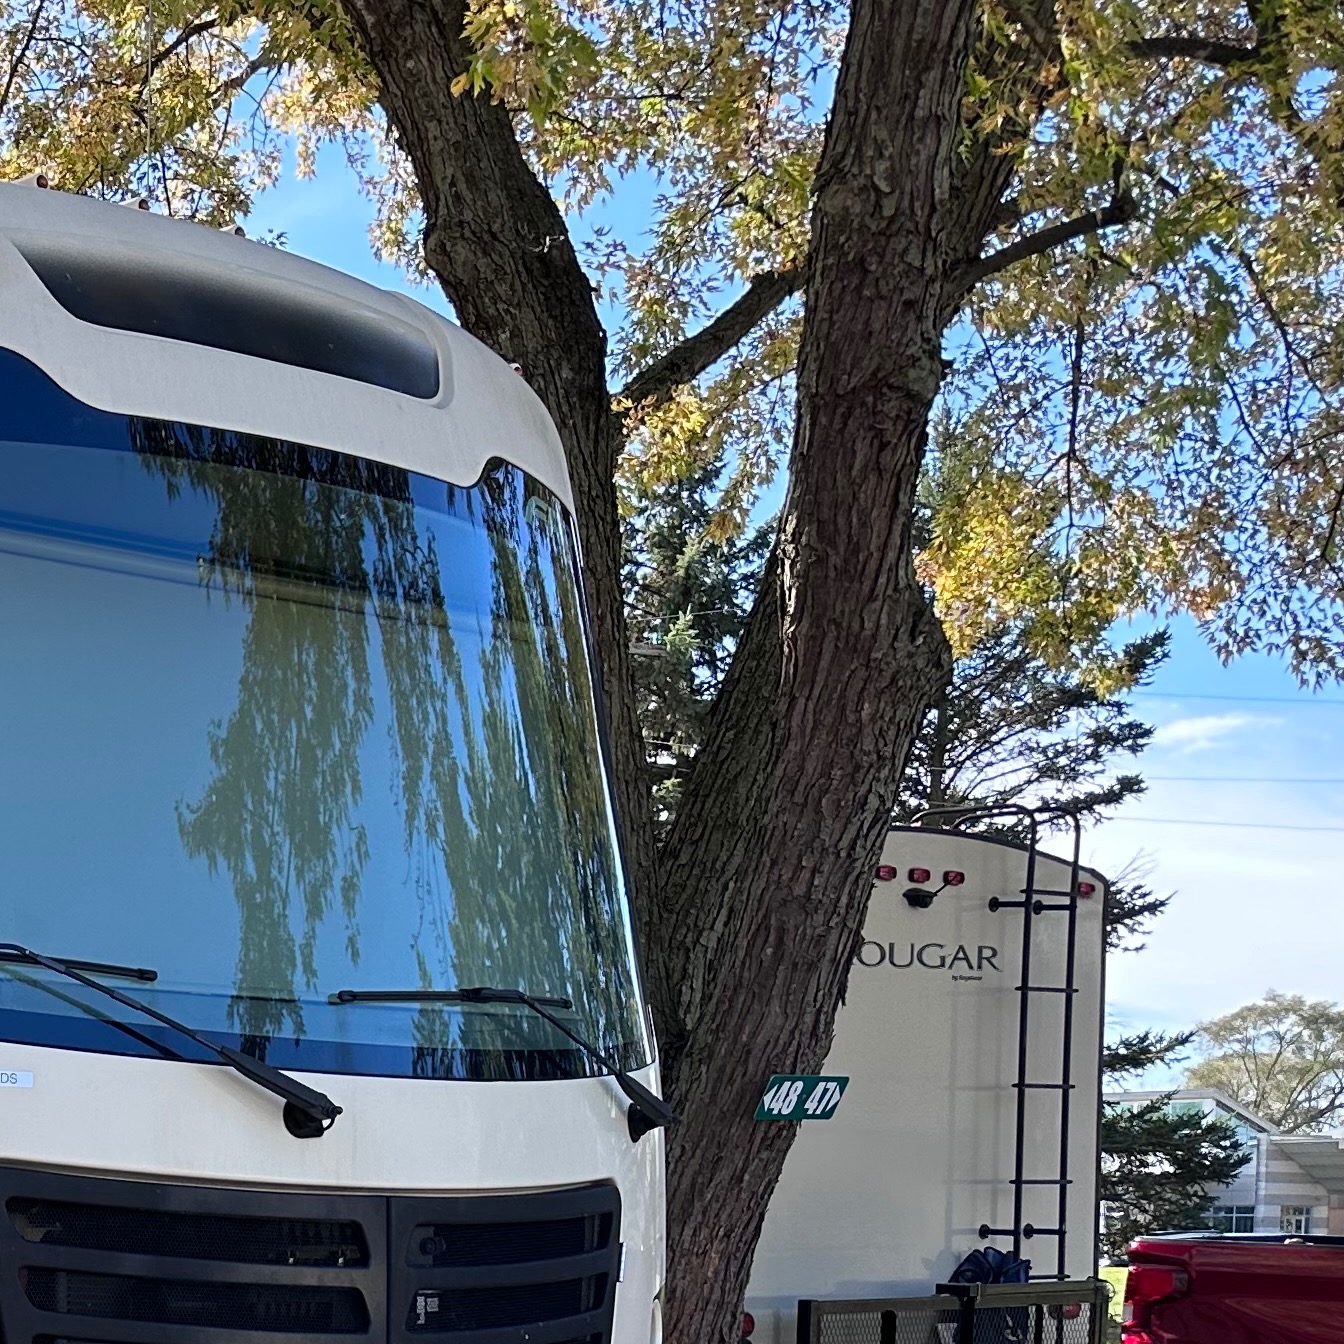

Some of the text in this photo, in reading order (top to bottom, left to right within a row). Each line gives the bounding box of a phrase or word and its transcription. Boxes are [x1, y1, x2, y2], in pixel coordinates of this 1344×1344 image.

[853, 940, 1003, 973] OUGAR
[769, 1080, 838, 1115] 48 47
